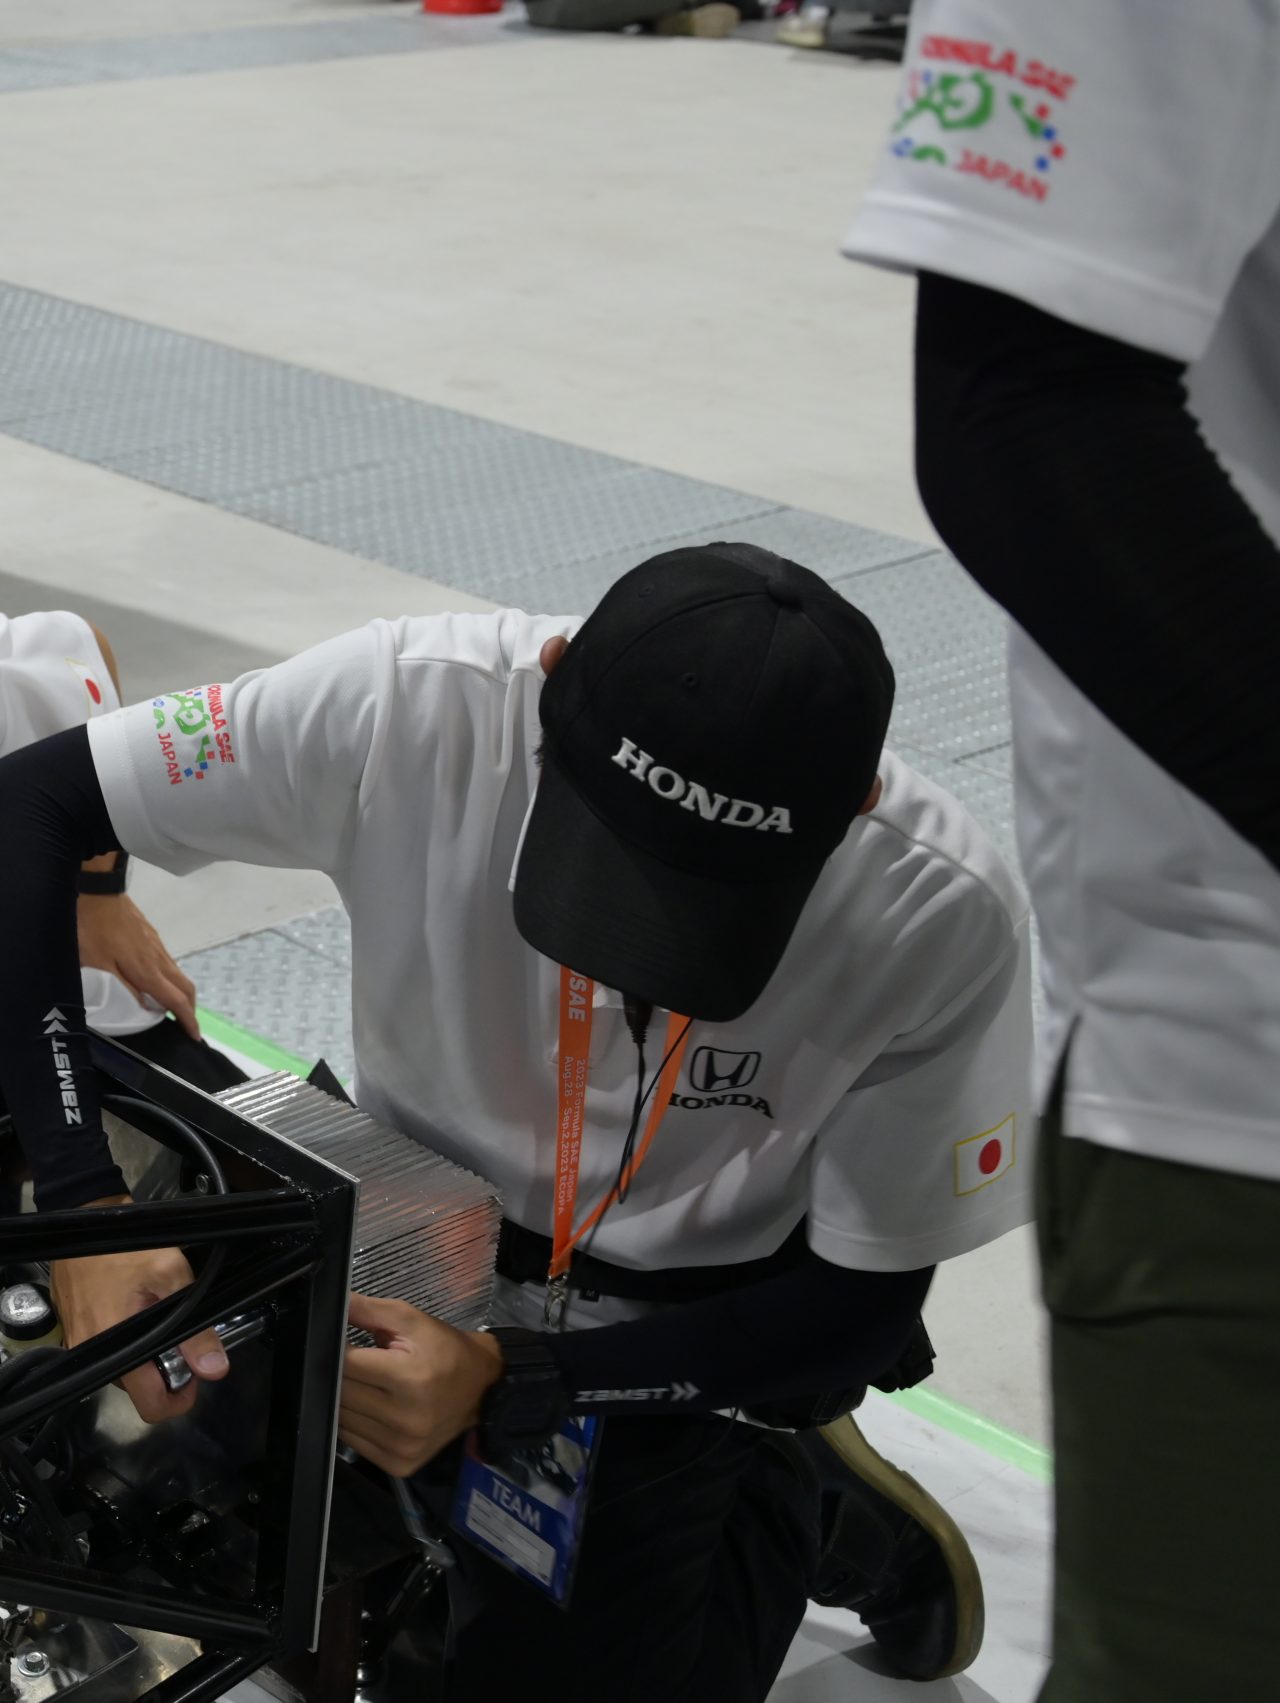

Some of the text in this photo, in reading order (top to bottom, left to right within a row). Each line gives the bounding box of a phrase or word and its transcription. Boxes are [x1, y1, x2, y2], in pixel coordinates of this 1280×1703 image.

[955, 149, 1048, 202] JAPAN
[158, 733, 183, 786] JAPAN
[215, 732, 236, 765] SAE
[611, 737, 794, 833] HONDA
[569, 969, 587, 1022] SAE
[575, 1058, 586, 1088] 2023
[571, 1092, 583, 1138] Formula
[570, 1141, 579, 1165] SAE
[492, 1477, 541, 1532] TEAM
